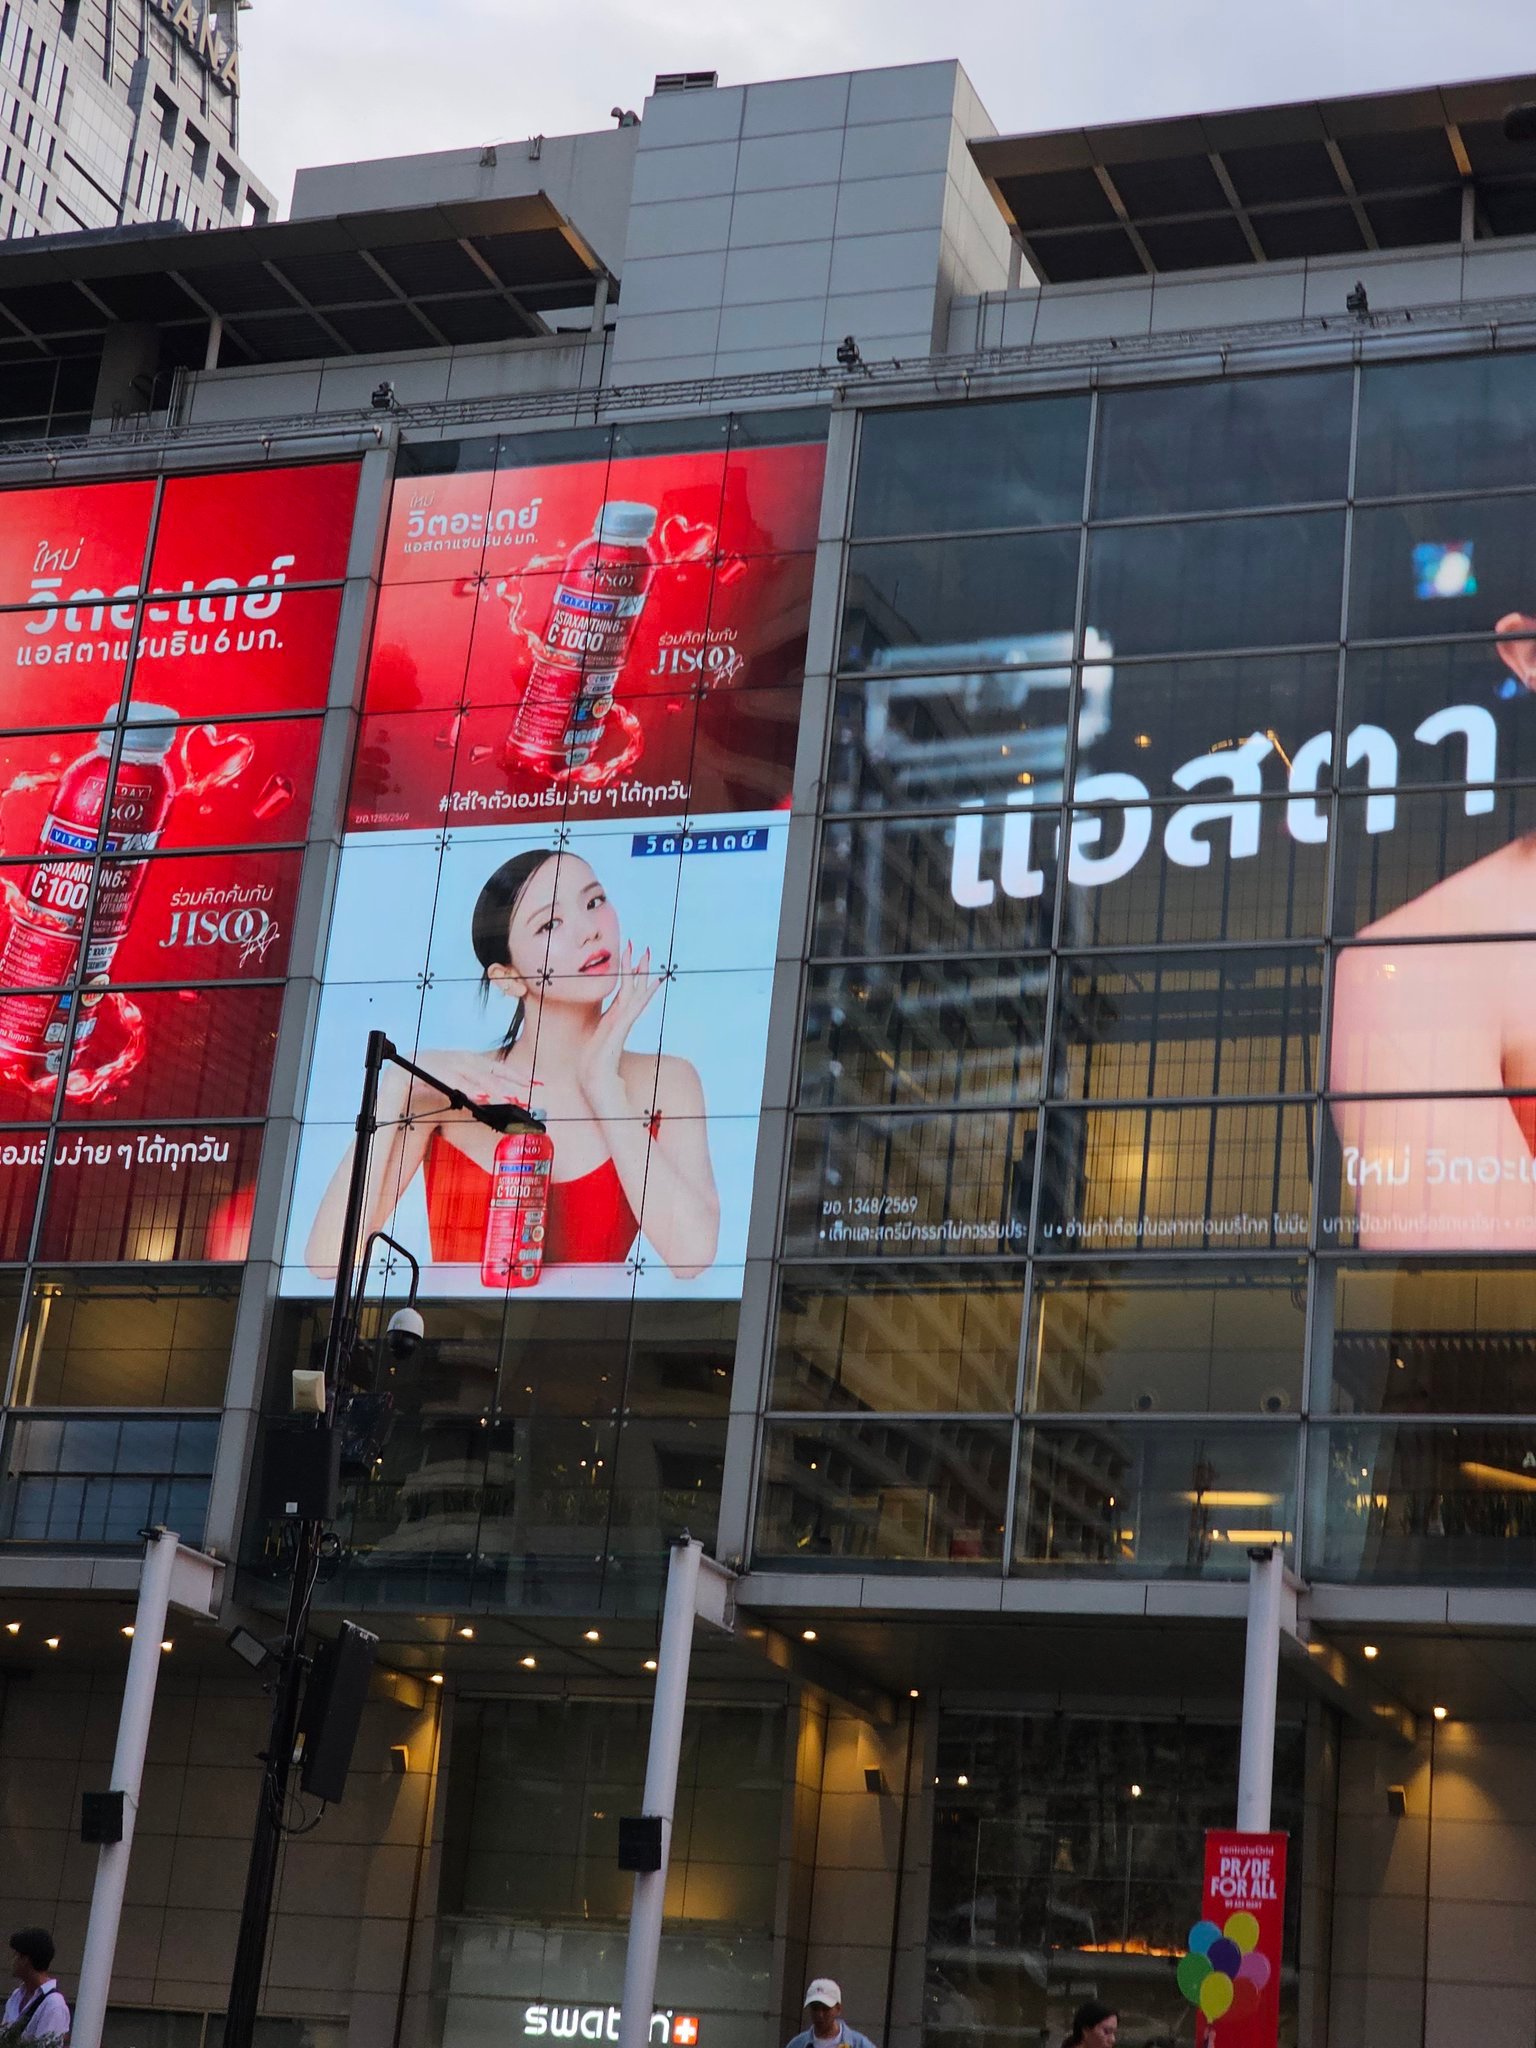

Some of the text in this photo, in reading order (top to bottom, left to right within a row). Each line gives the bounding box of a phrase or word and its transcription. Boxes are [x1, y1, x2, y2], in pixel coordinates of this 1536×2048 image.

[407, 498, 543, 538] วิตอะเดย์
[33, 538, 84, 572] ใหม่
[650, 645, 736, 675] JISOO
[950, 703, 1498, 908] แอสตา
[170, 883, 274, 906] ร่วมคิดค้นกับ
[159, 908, 269, 948] JISOO
[1343, 1144, 1411, 1187] ใหม่
[1210, 1875, 1278, 1900] FOR ALL
[524, 2006, 671, 2045] swath
